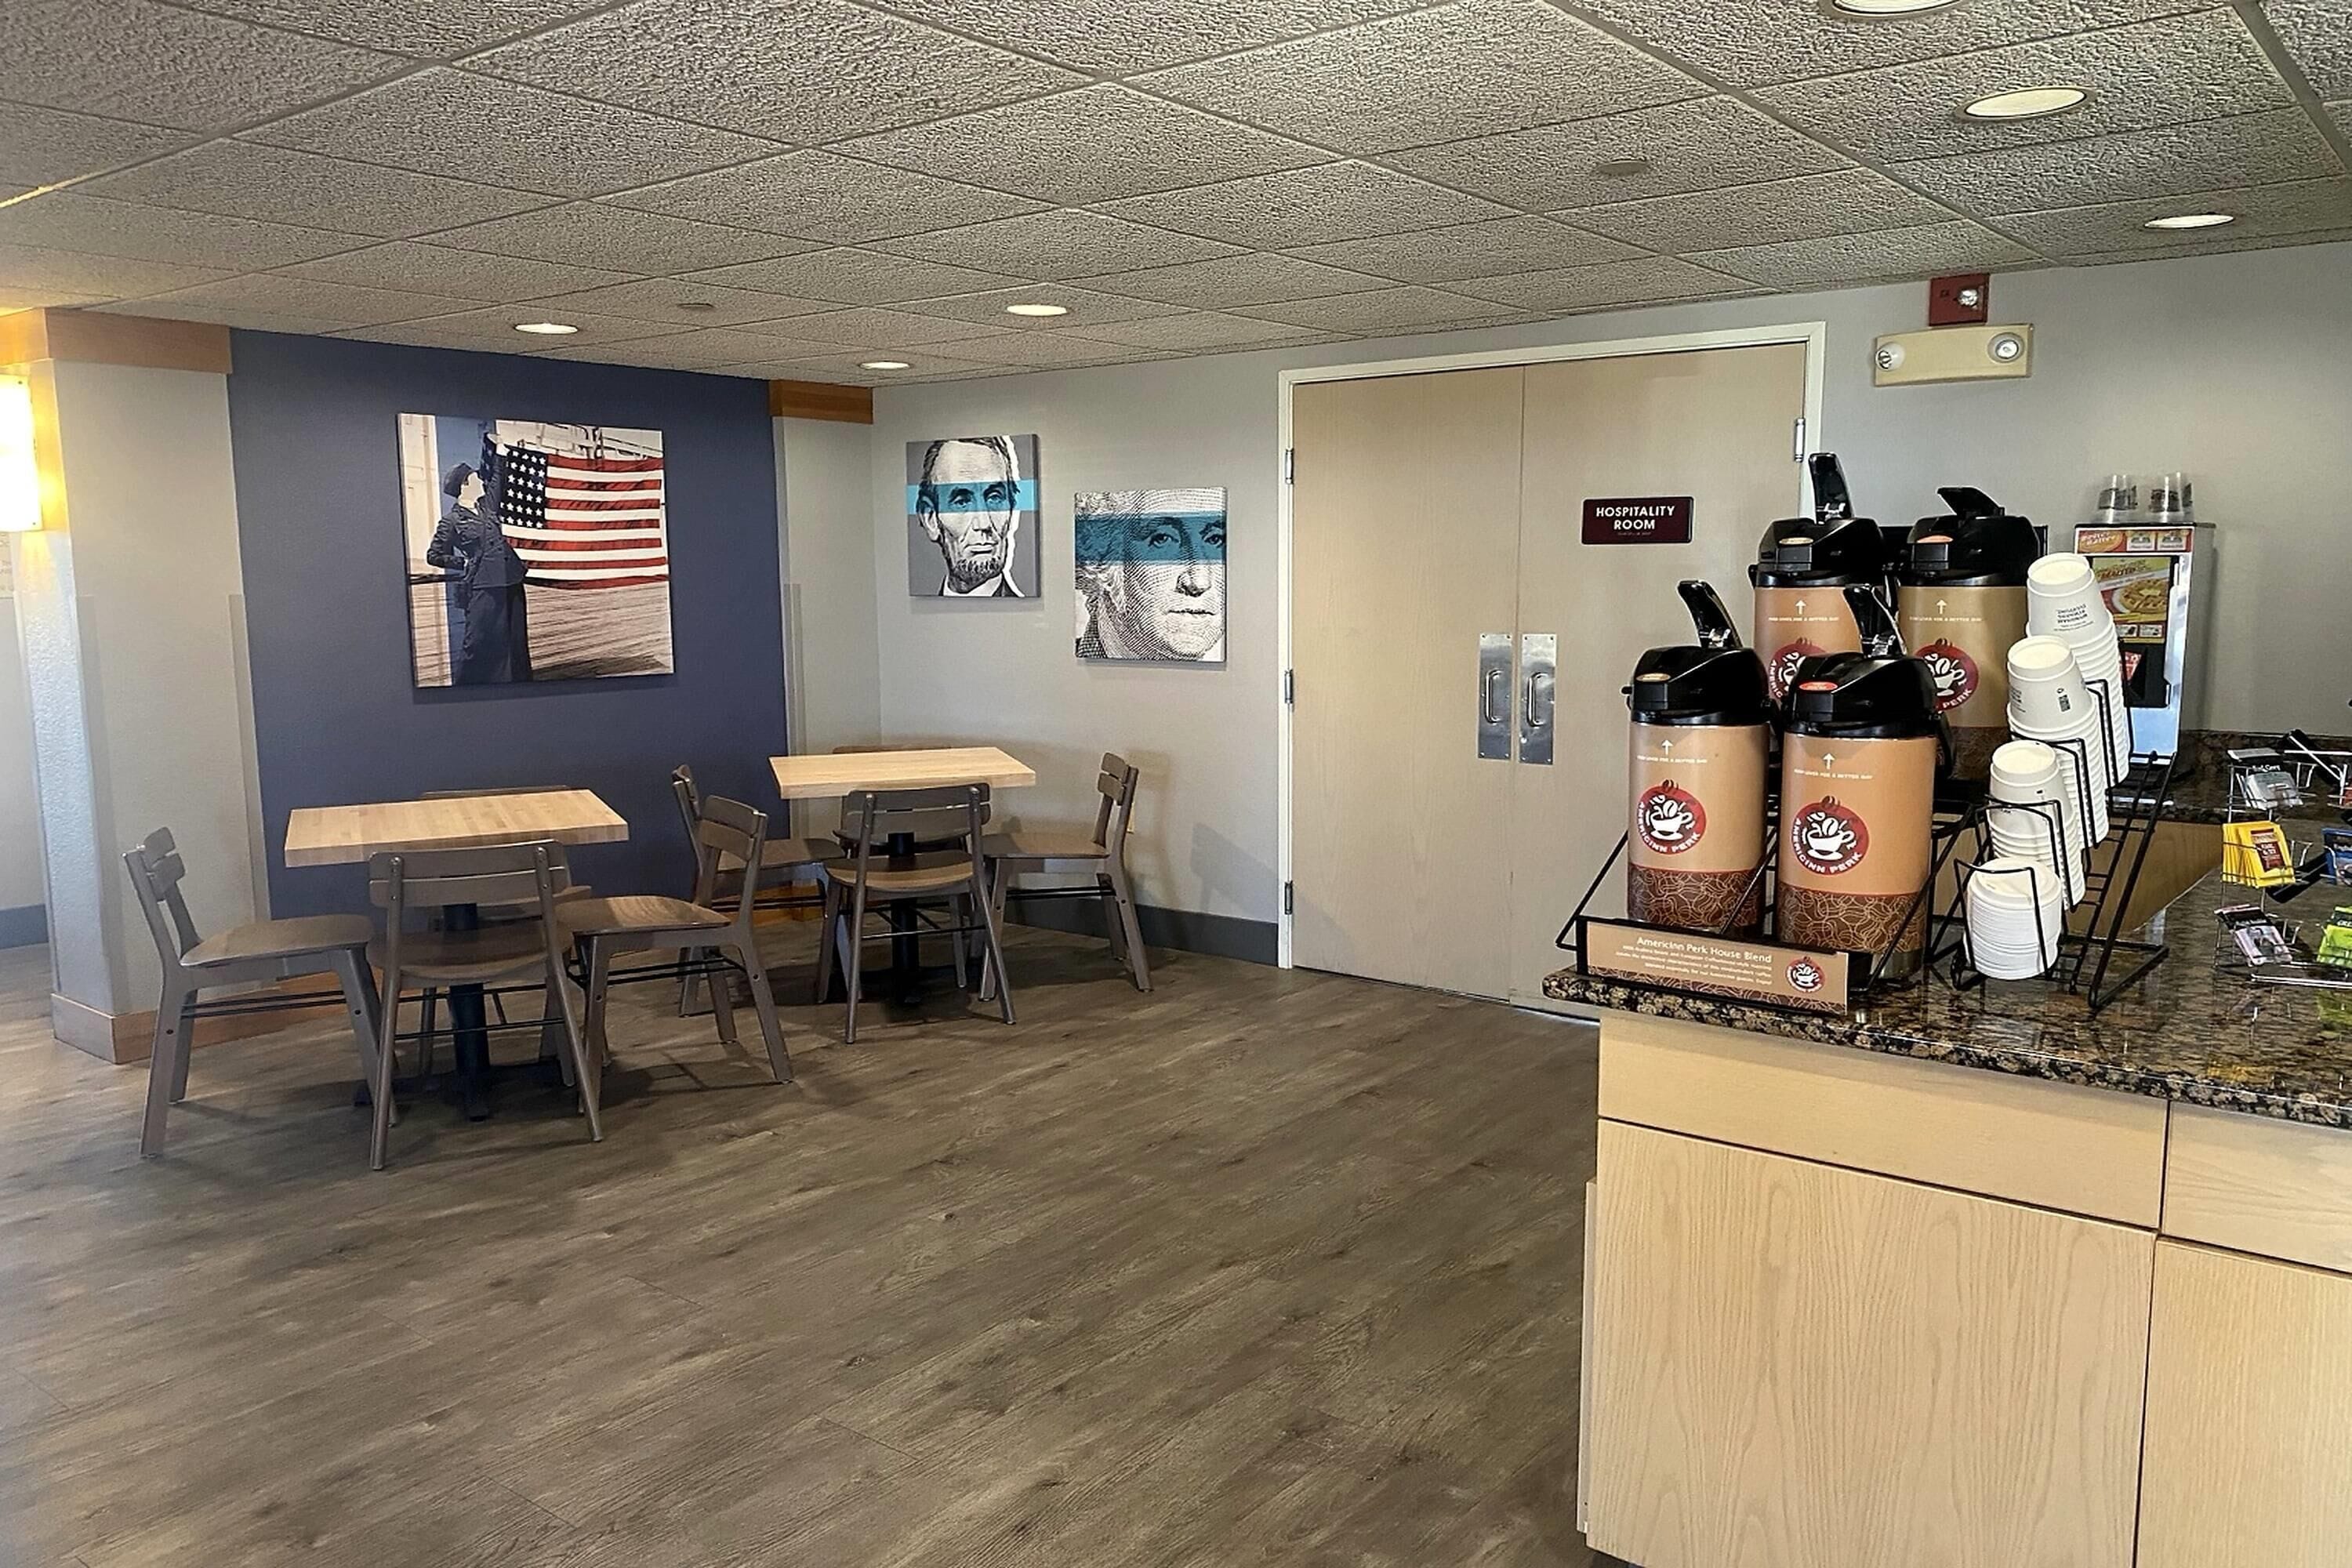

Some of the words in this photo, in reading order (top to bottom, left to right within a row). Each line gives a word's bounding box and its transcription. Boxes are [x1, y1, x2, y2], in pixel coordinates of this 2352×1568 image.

[1595, 506, 1675, 517] HOSPITALITY
[1613, 519, 1656, 530] ROOM
[1769, 659, 1784, 699] AMERIC
[1942, 688, 1973, 709] PERK
[1638, 801, 1668, 853] AMERICINN
[1671, 831, 1701, 853] PERK
[1792, 818, 1826, 873] AMERICINN
[1829, 851, 1863, 873] PERK
[1686, 943, 1708, 954] Perk
[1710, 946, 1742, 959] House
[1744, 951, 1773, 964] Blend
